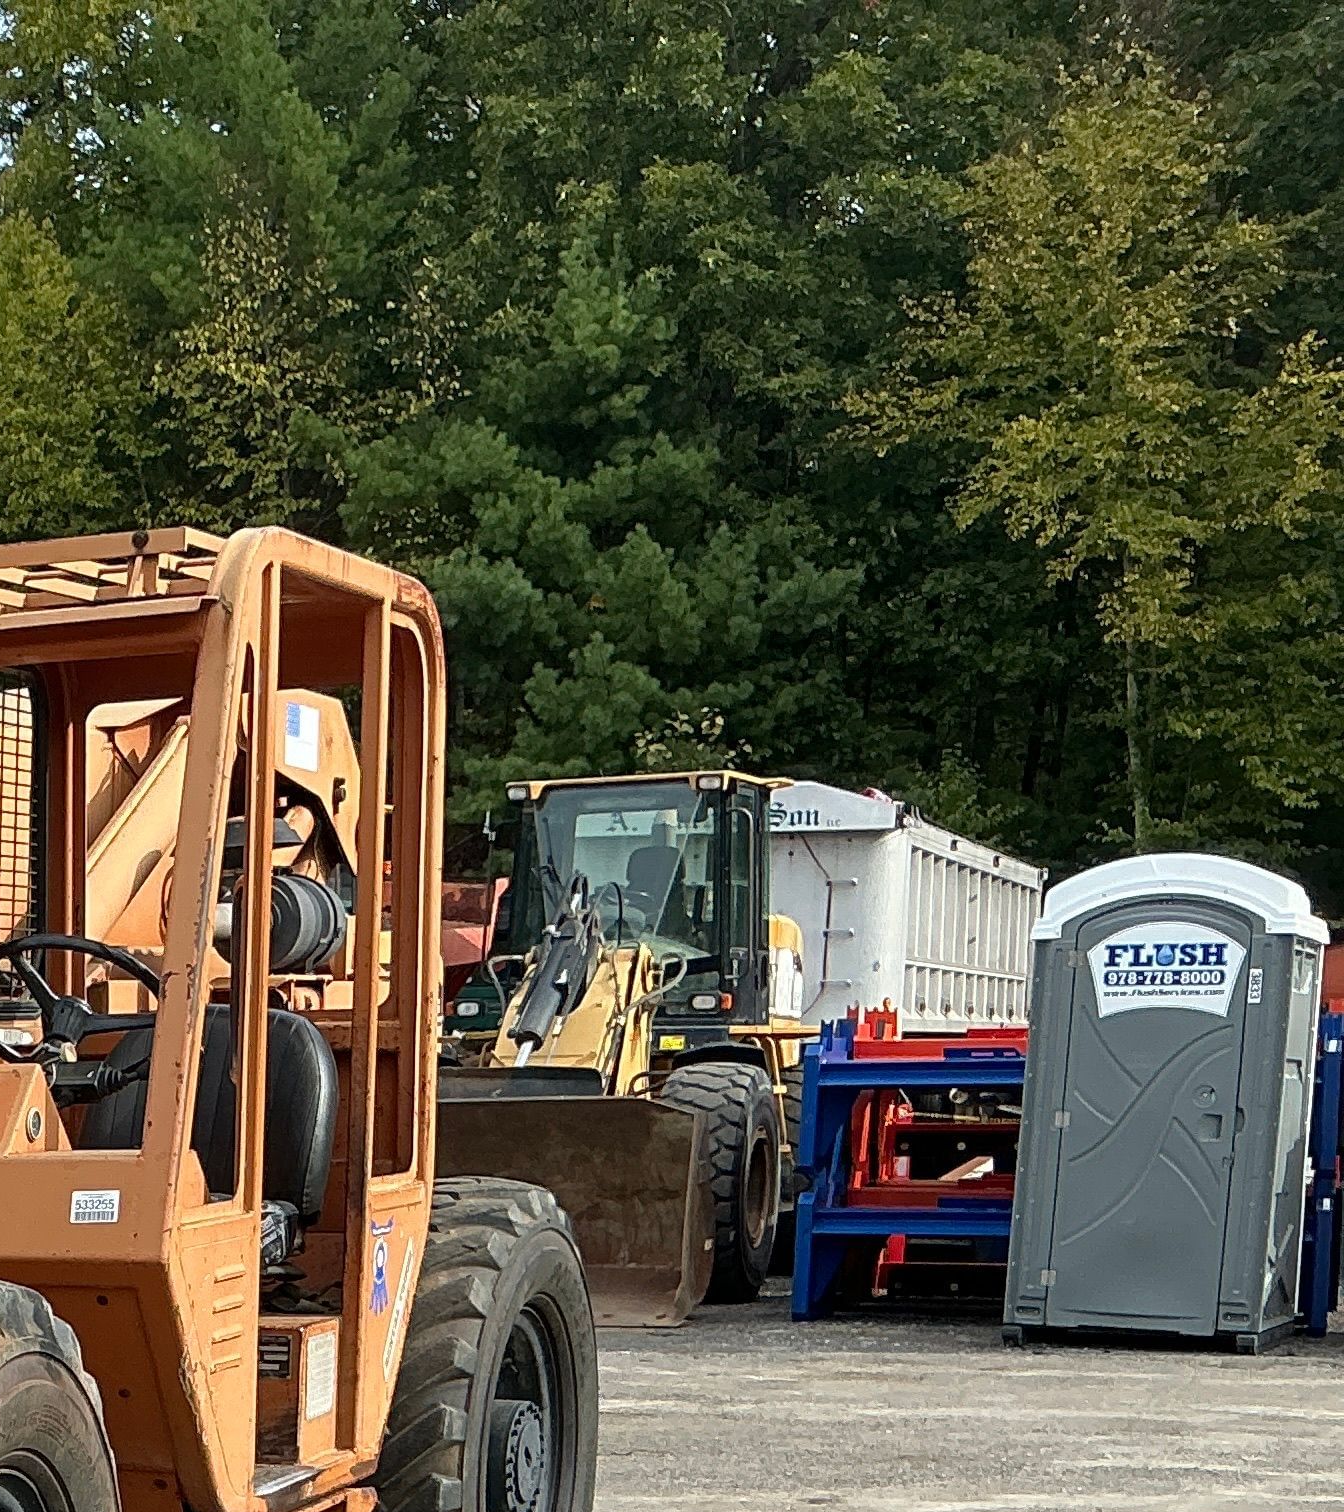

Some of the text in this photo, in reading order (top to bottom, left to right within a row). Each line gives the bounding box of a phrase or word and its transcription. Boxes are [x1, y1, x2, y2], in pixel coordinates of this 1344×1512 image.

[1103, 943, 1229, 967] FLUSH
[1107, 970, 1222, 986] 978-778-8000
[74, 1198, 115, 1211] 533255
